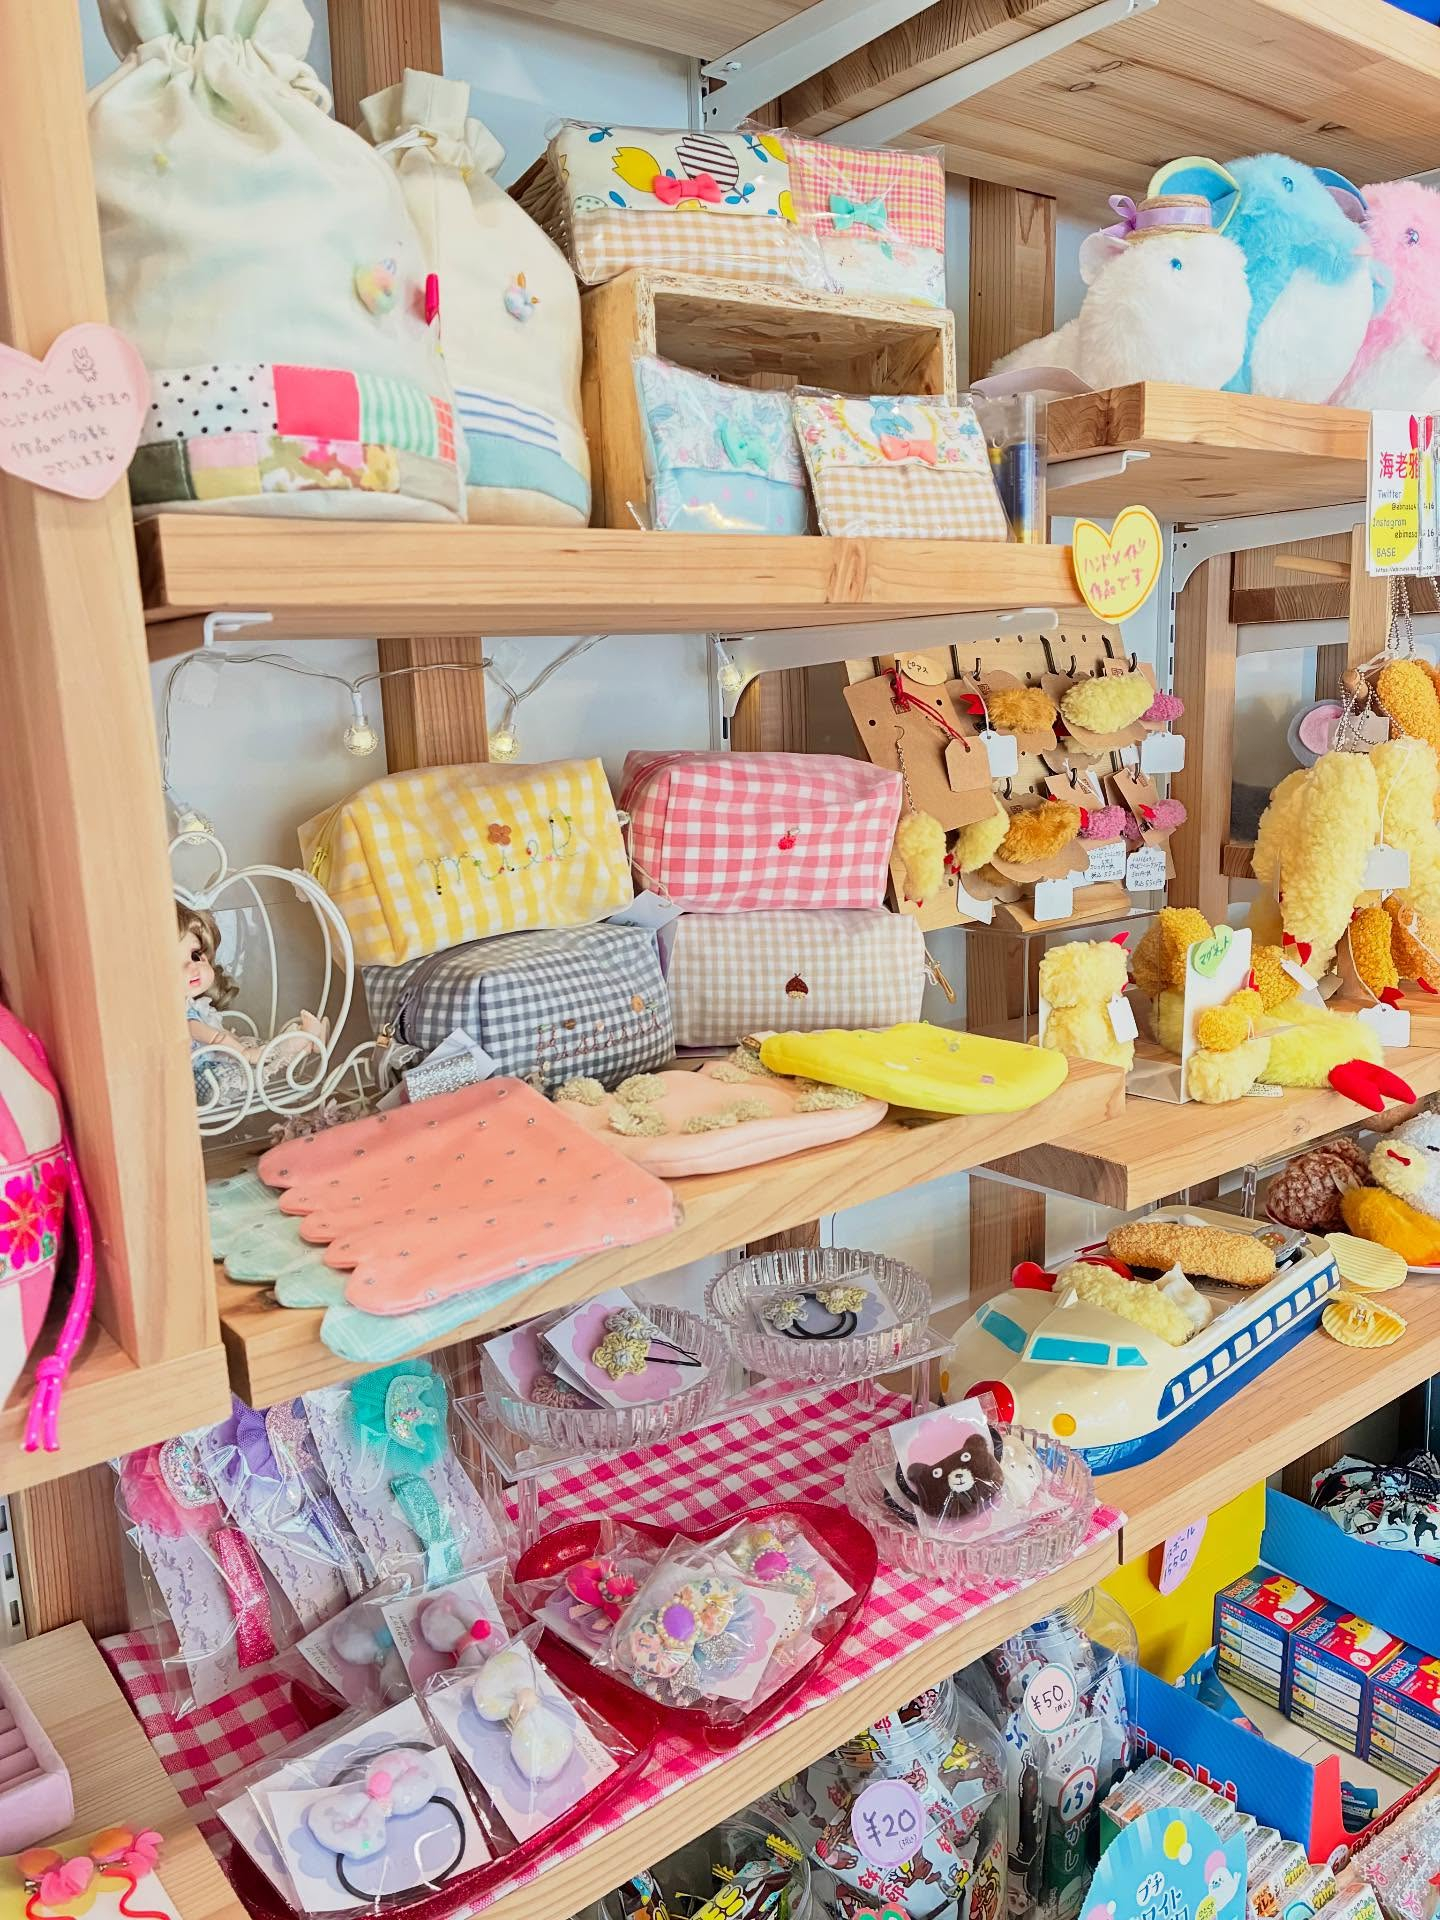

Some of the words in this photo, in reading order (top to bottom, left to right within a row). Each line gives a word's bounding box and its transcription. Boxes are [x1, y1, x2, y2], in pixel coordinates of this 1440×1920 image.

[1377, 489, 1402, 499] Twitter
[1372, 517, 1407, 529] Instagram
[1376, 547, 1396, 558] BASE
[1090, 567, 1144, 602] 作品です
[1031, 1685, 1064, 1715] ¥50
[863, 1808, 916, 1847] ¥20
[1138, 1873, 1163, 1903] プチ
